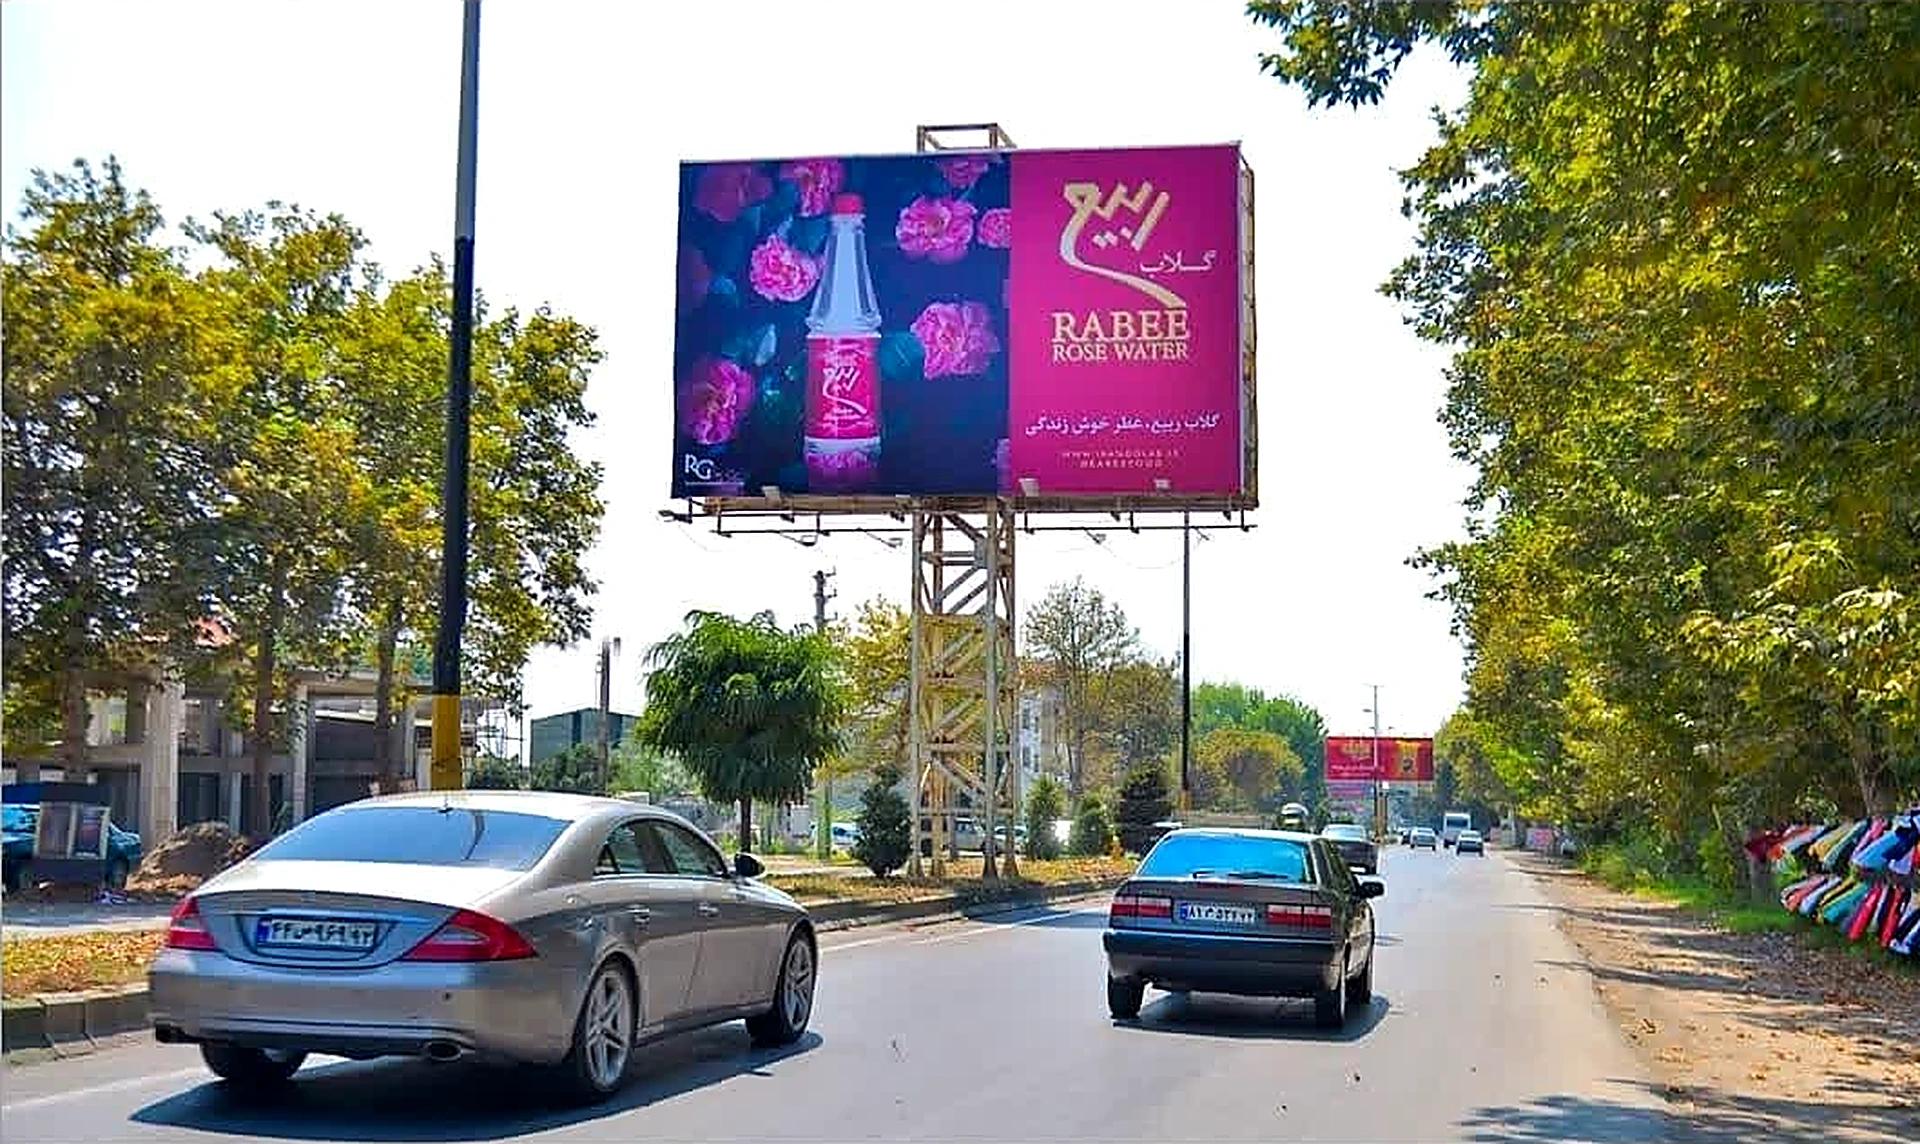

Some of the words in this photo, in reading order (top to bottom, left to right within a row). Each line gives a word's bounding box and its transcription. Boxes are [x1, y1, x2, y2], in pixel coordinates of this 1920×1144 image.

[1139, 250, 1217, 279] گلاب
[1051, 310, 1190, 343] RABEE
[1053, 344, 1108, 363] ROSE
[1112, 341, 1188, 362] WATER
[684, 453, 715, 480] RG
